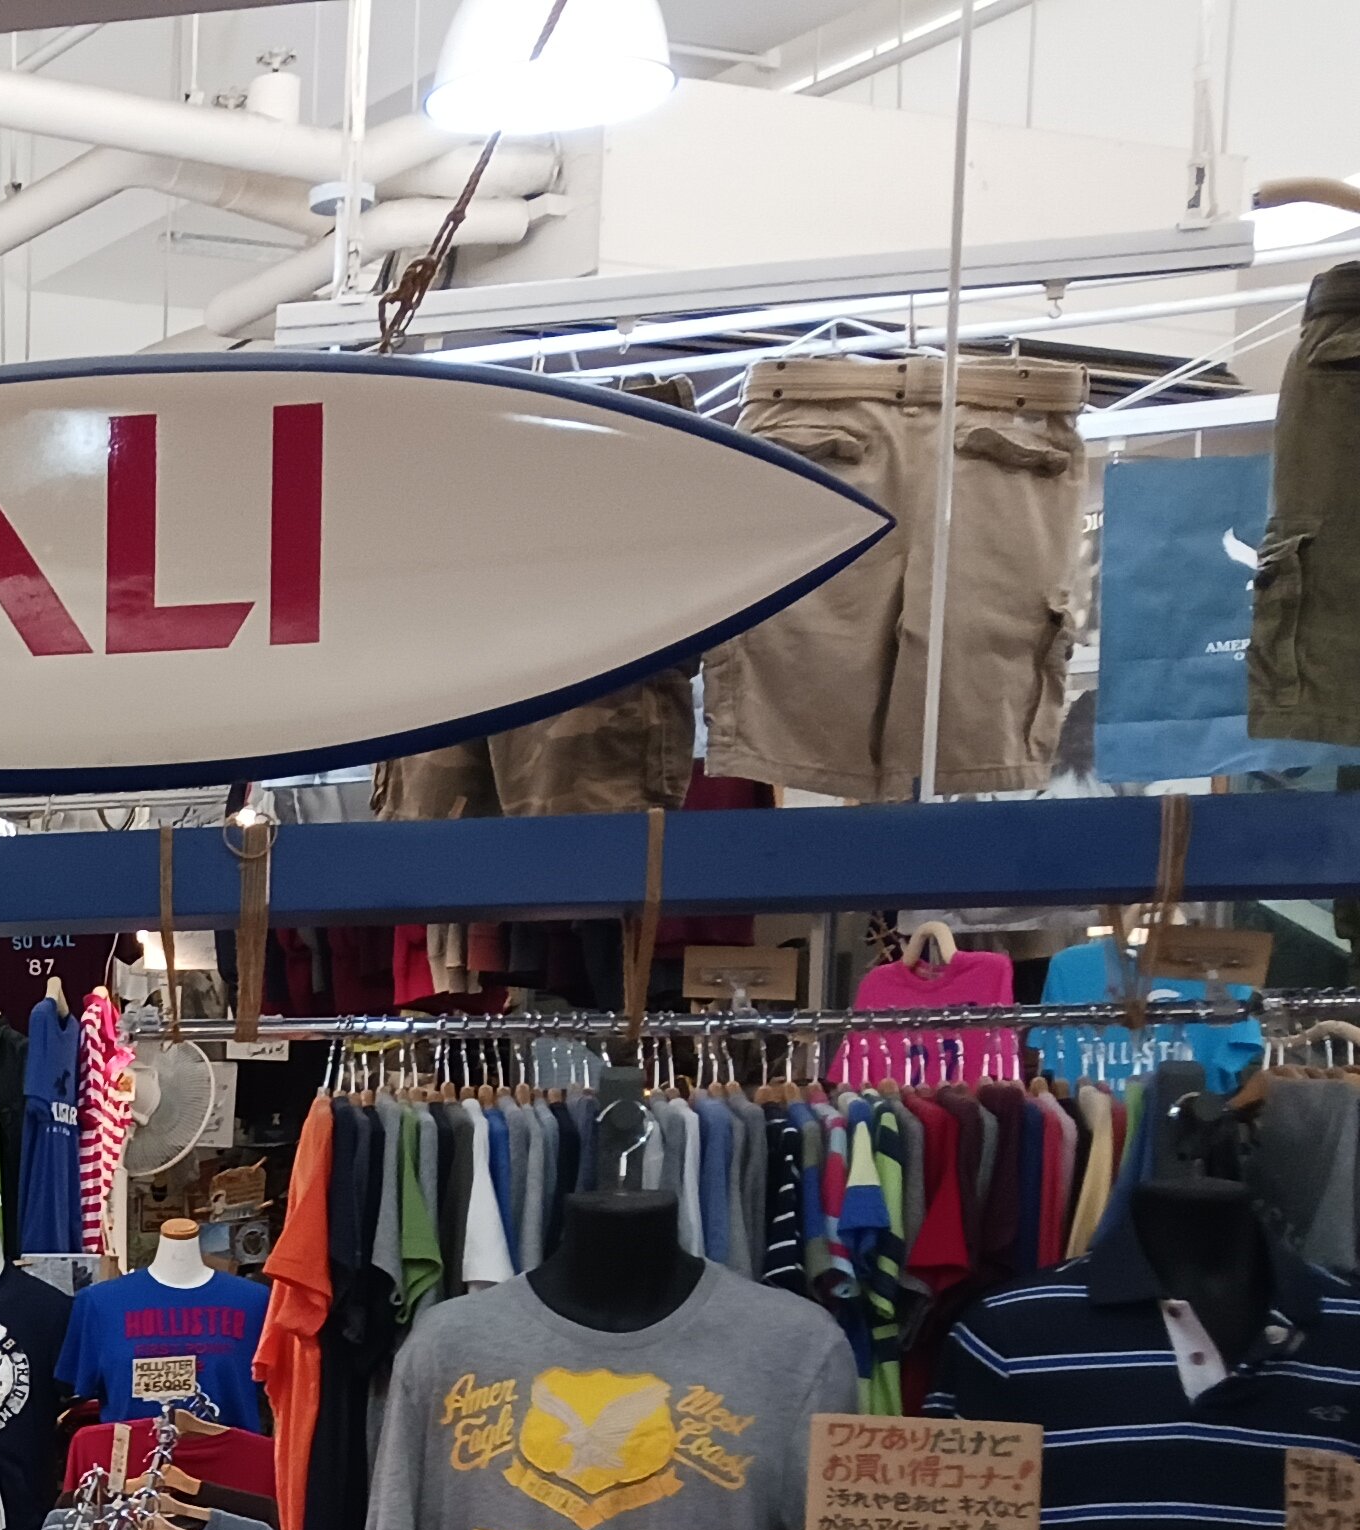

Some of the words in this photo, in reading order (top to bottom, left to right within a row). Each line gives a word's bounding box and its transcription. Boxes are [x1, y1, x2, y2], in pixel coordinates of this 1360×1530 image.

[12, 936, 34, 950] SO
[41, 934, 76, 949] CAL
[125, 1307, 245, 1340] HOLLISTER
[135, 1360, 193, 1373] HOLLISTER
[442, 1374, 518, 1425] Amer
[678, 1385, 756, 1436] West
[450, 1413, 516, 1471] Eagle
[828, 1422, 1020, 1458] ワケありだけど
[823, 1454, 1035, 1490] お買い得コーナー!
